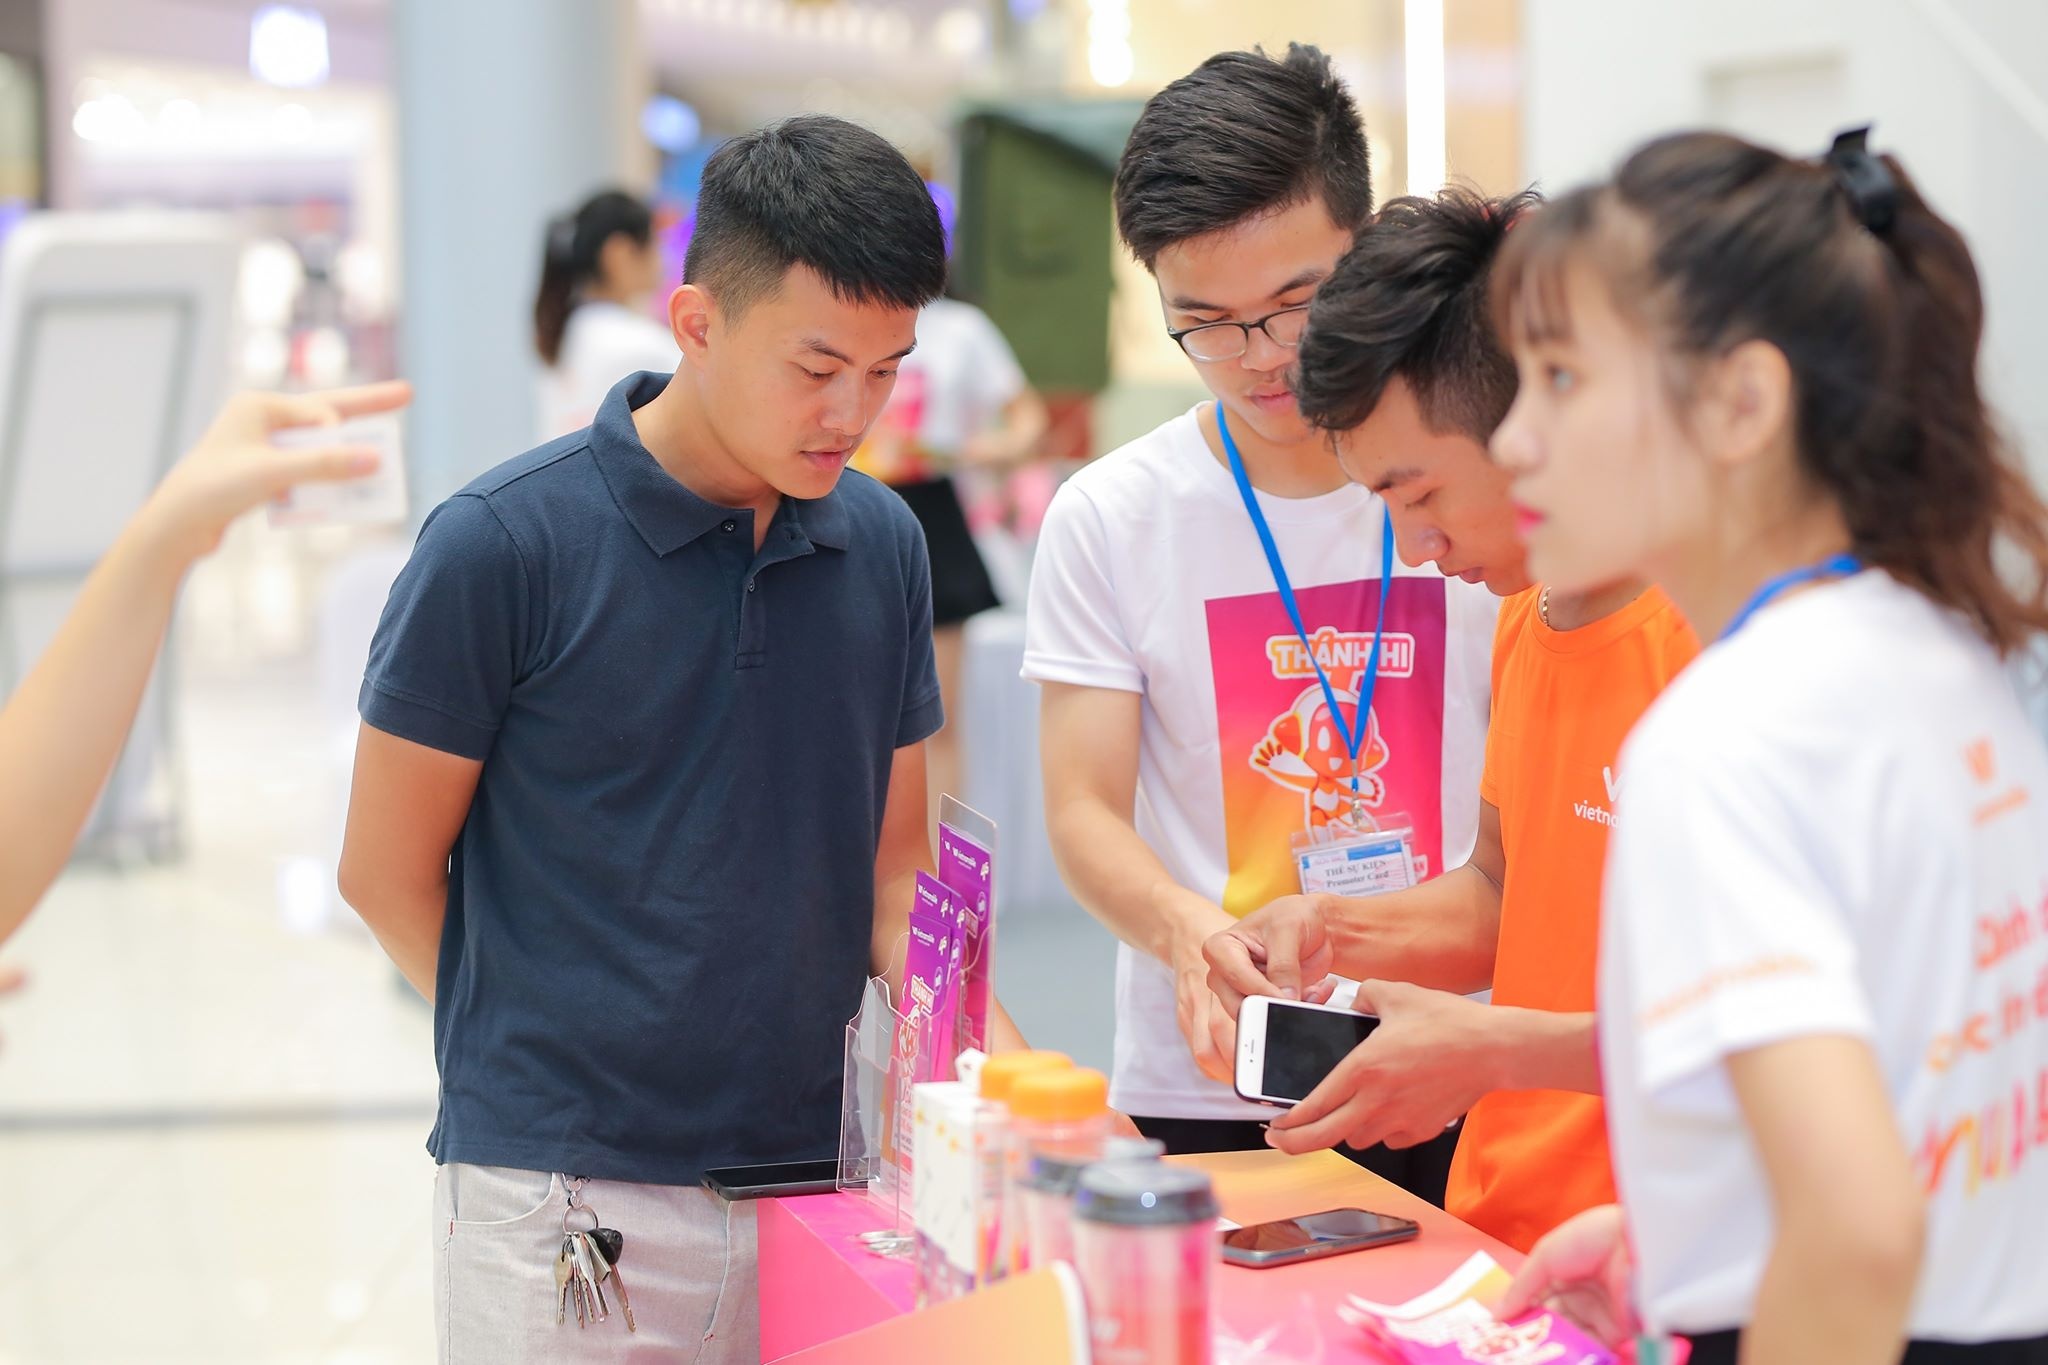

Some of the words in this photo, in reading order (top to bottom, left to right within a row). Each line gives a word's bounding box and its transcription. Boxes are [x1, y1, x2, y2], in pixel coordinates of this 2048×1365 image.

[1276, 636, 1372, 669] THÁNH
[1381, 642, 1408, 668] HI
[1367, 871, 1389, 880] Card
